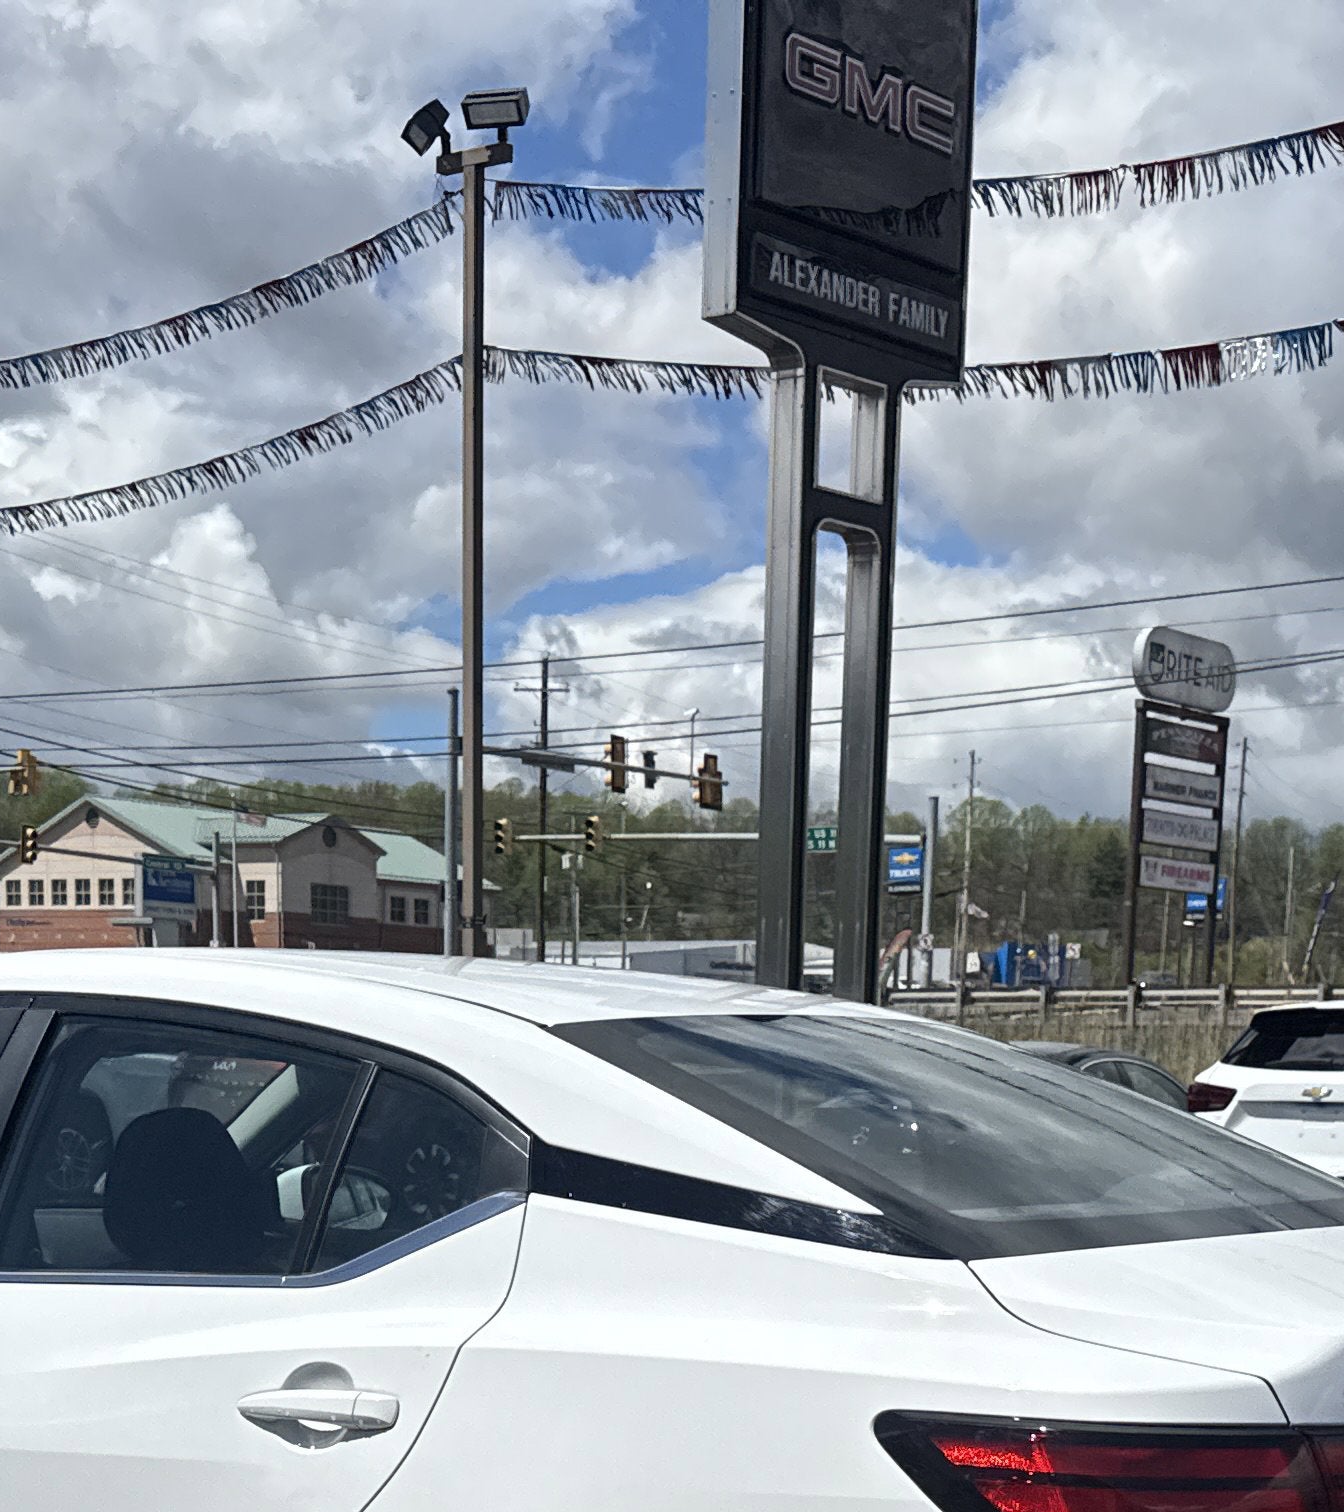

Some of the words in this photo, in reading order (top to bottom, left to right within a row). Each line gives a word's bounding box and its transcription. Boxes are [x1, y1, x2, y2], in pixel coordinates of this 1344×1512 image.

[786, 33, 954, 155] GMC
[769, 252, 881, 317] ALEXANDER
[888, 292, 949, 338] FAMILY
[1166, 650, 1203, 686] RITE
[1205, 664, 1233, 693] AID
[1161, 864, 1211, 882] FIREARMS
